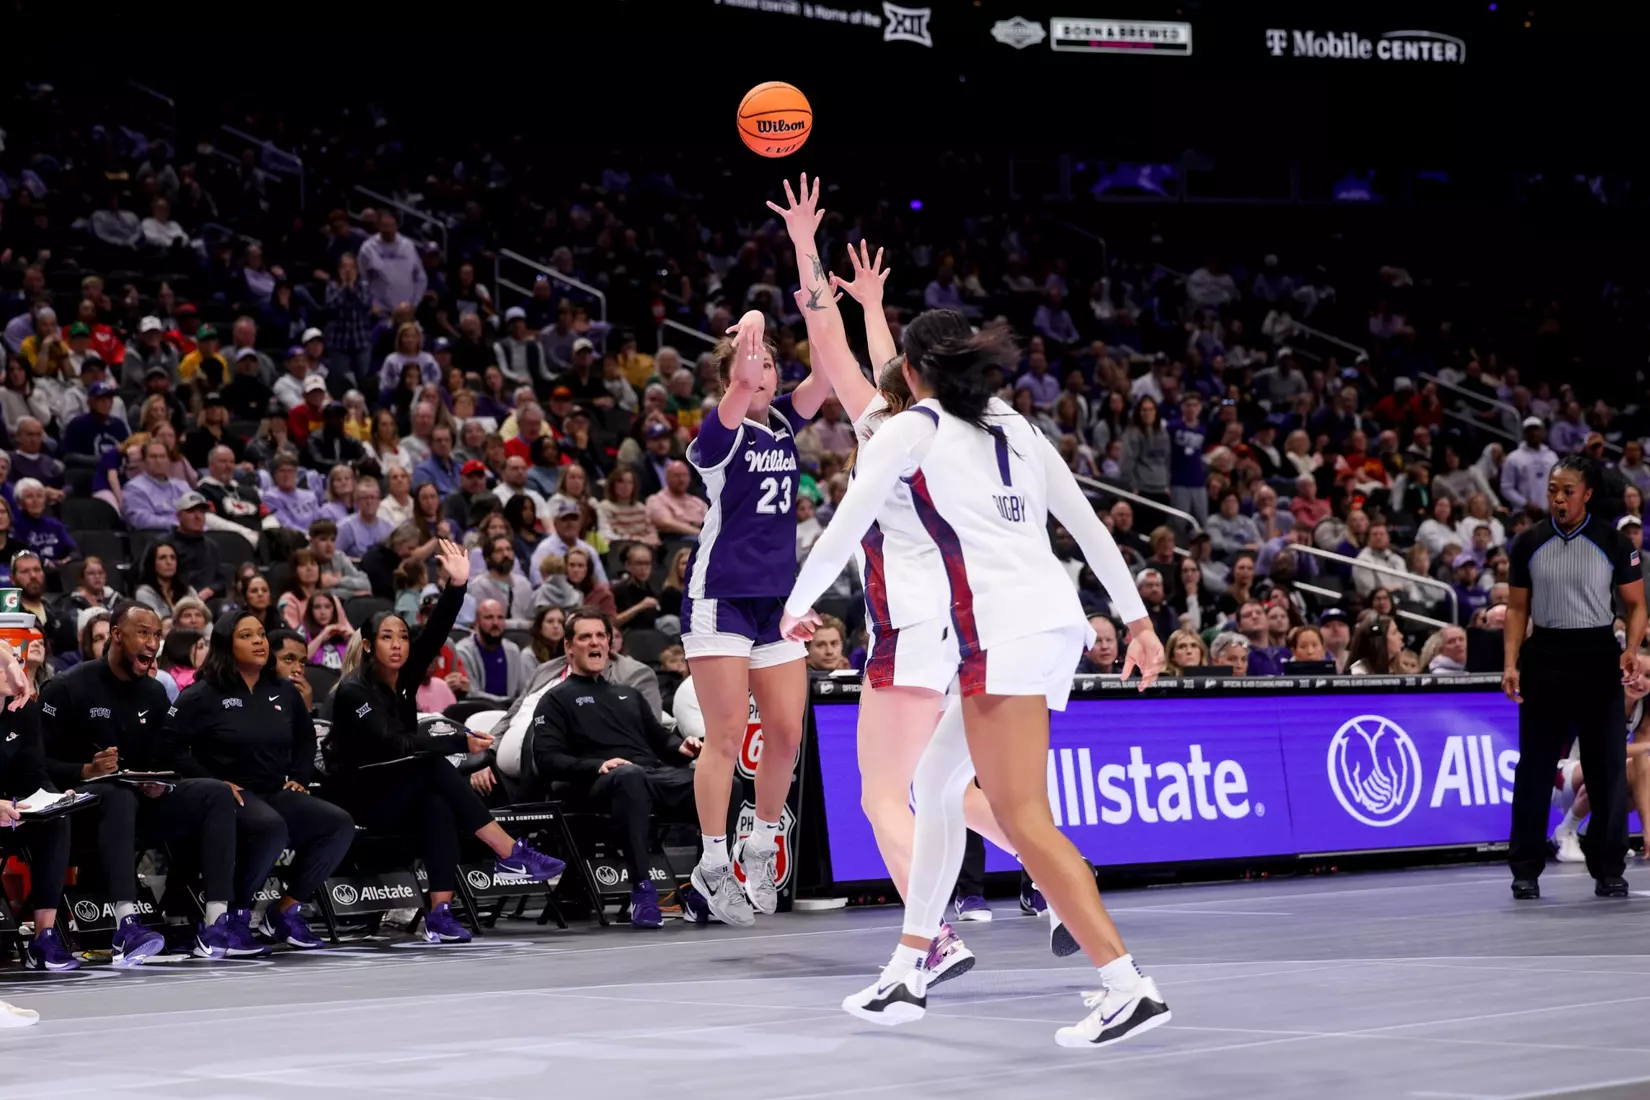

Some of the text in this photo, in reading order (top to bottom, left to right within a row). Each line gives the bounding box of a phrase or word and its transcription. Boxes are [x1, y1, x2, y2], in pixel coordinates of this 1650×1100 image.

[1292, 29, 1373, 60] Mobile
[1376, 39, 1459, 62] CENTER
[756, 119, 805, 133] Wilson
[756, 475, 792, 514] 23
[90, 707, 111, 718] TCU
[1429, 735, 1521, 808] Alls
[360, 884, 414, 901] Allstate
